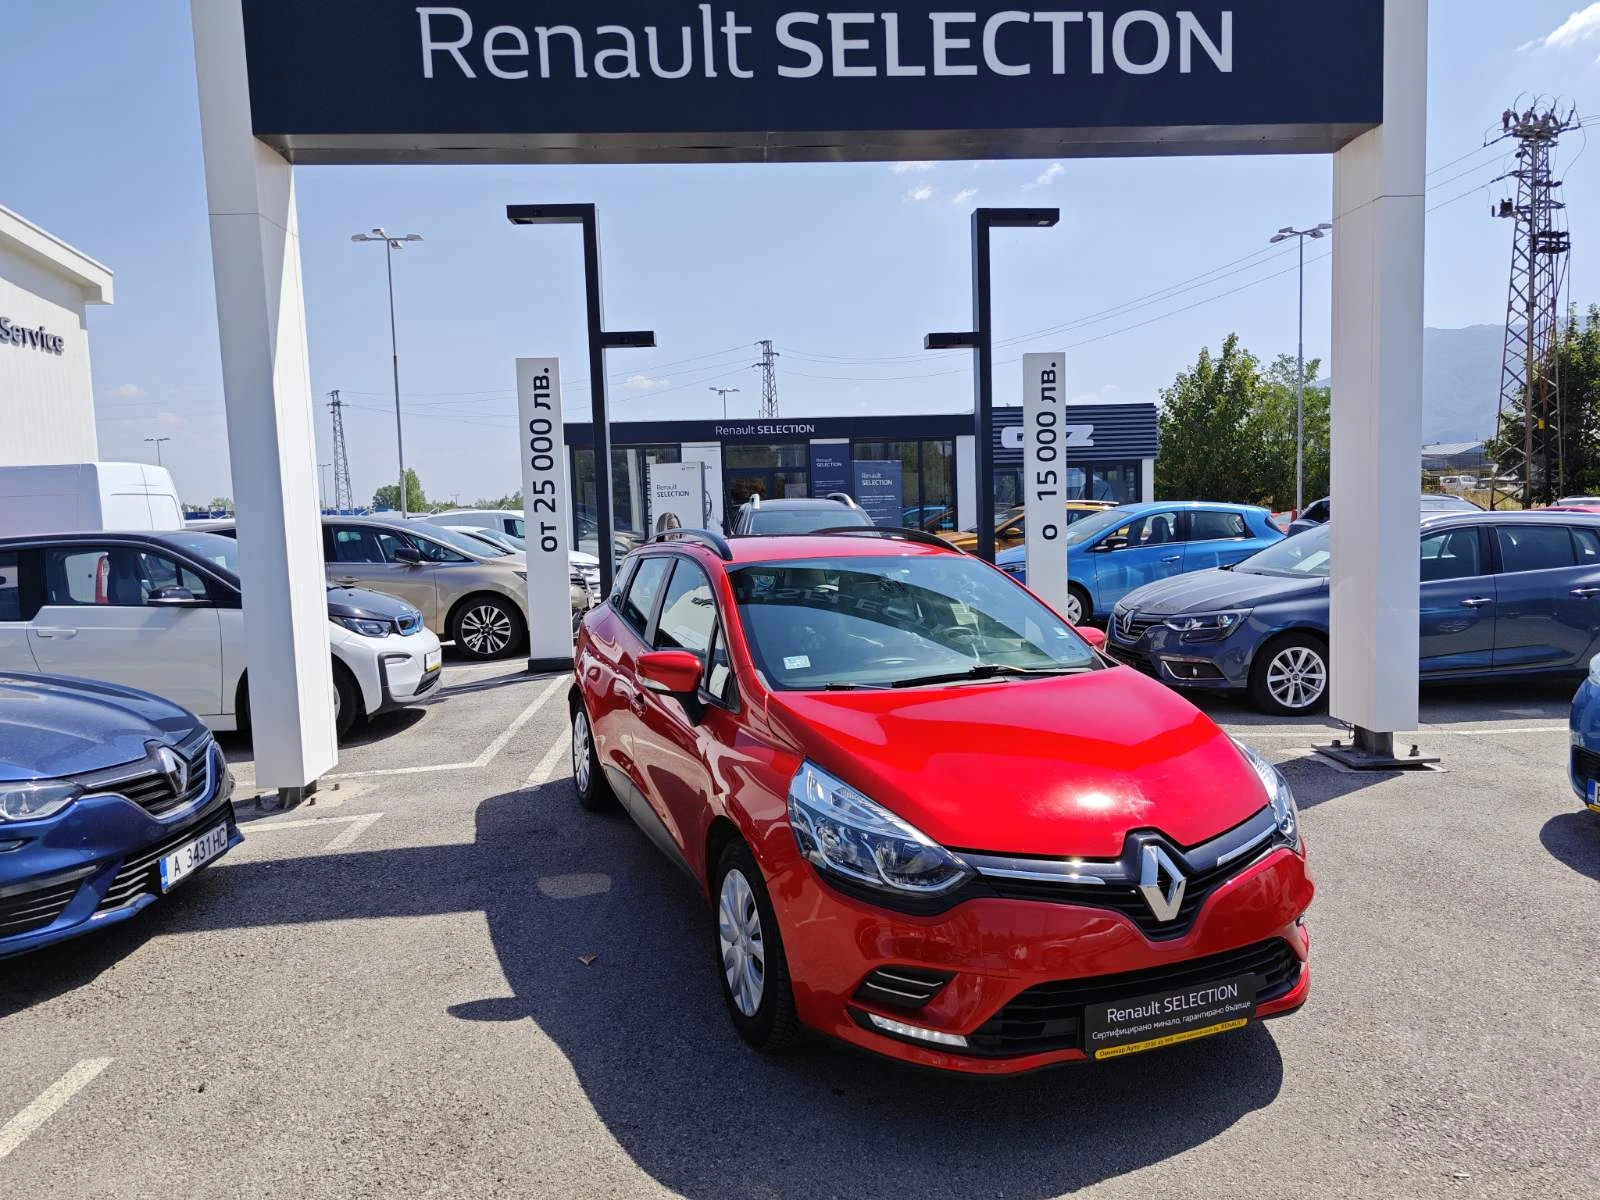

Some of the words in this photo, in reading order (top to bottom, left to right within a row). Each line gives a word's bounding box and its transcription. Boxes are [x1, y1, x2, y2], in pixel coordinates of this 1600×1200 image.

[416, 3, 754, 80] Renault
[775, 9, 1234, 79] SELECTION
[0, 316, 65, 356] Service
[533, 367, 551, 410] лв.
[1040, 361, 1056, 403] лв.
[529, 418, 554, 471] 000
[715, 425, 755, 436] Renault
[757, 424, 815, 434] SELECTION
[1036, 411, 1057, 463] 000
[532, 479, 556, 513] 25
[656, 490, 690, 498] SELECTION
[1037, 470, 1057, 502] 15
[540, 521, 558, 553] от
[1107, 1000, 1161, 1023] Renault
[1163, 983, 1239, 1012] SELECTION
[1092, 1023, 1153, 1040] Сертифицирано
[1182, 1007, 1225, 1023] гарантирано
